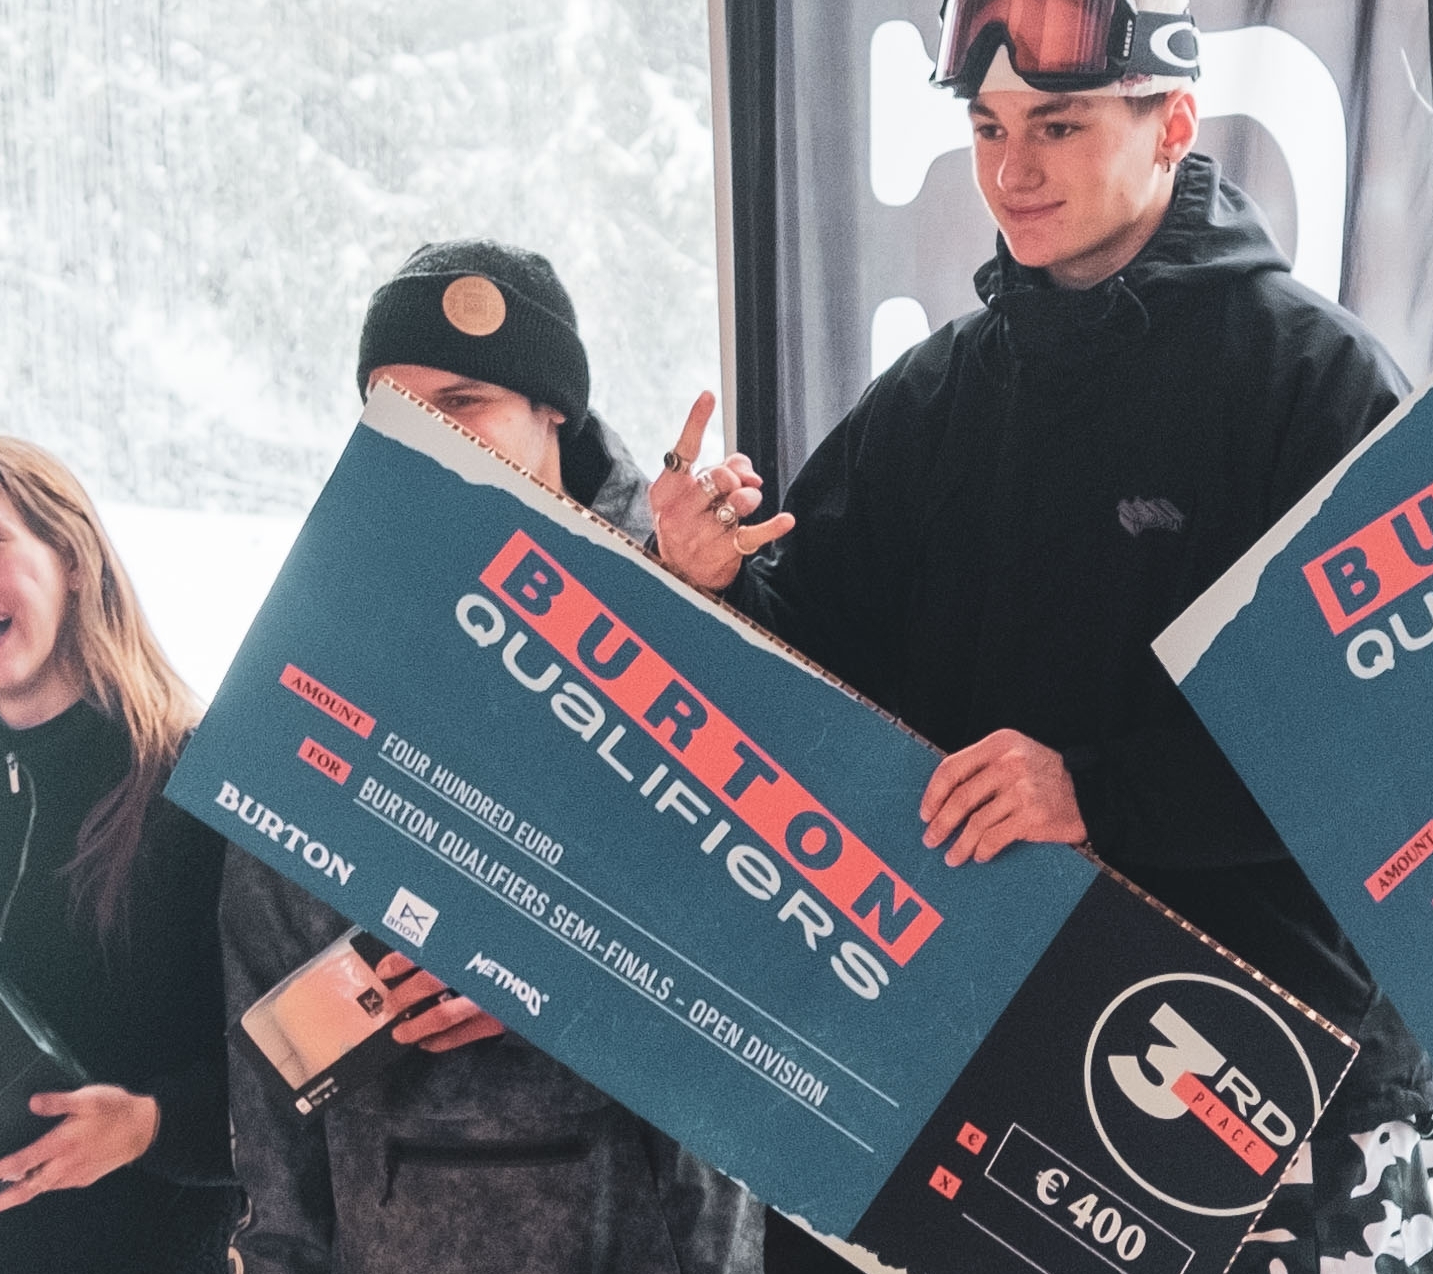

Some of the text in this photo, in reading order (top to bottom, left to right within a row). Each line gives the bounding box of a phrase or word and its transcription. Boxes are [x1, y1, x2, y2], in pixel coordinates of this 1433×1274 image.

[291, 677, 366, 729] AMOUNT
[307, 745, 341, 777] FOR
[501, 548, 922, 946] BURTON
[382, 732, 565, 867] FOUR HUNDRED EURO
[215, 780, 356, 886] BURTON
[358, 776, 439, 843] BURTON
[439, 830, 550, 917] QUALIFIERS
[549, 902, 675, 1002] SEMI-FINALS
[689, 998, 745, 1050] OPEN
[743, 1035, 830, 1108] DIVISION
[386, 914, 421, 943] anon
[464, 952, 546, 1017] METHOD
[1108, 1003, 1296, 1147] 3RD
[1191, 1092, 1259, 1157] PLACE
[938, 1174, 954, 1192] X
